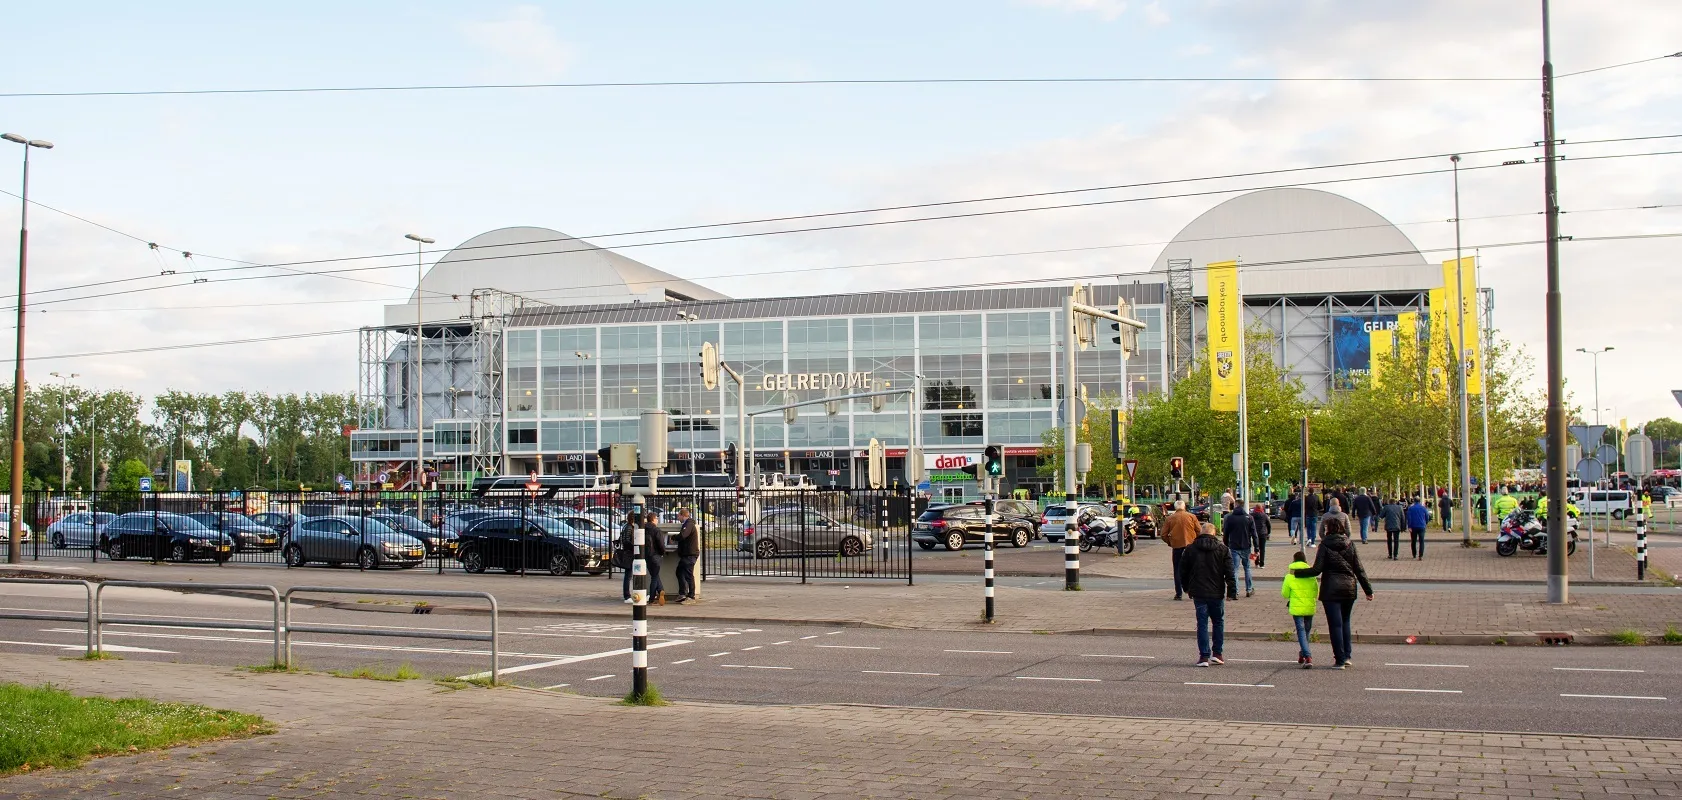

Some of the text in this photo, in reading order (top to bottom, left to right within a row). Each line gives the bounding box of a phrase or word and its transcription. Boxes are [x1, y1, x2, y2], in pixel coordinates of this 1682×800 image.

[763, 371, 872, 391] GELREDOME
[935, 455, 967, 469] dam
[379, 474, 386, 483] Q
